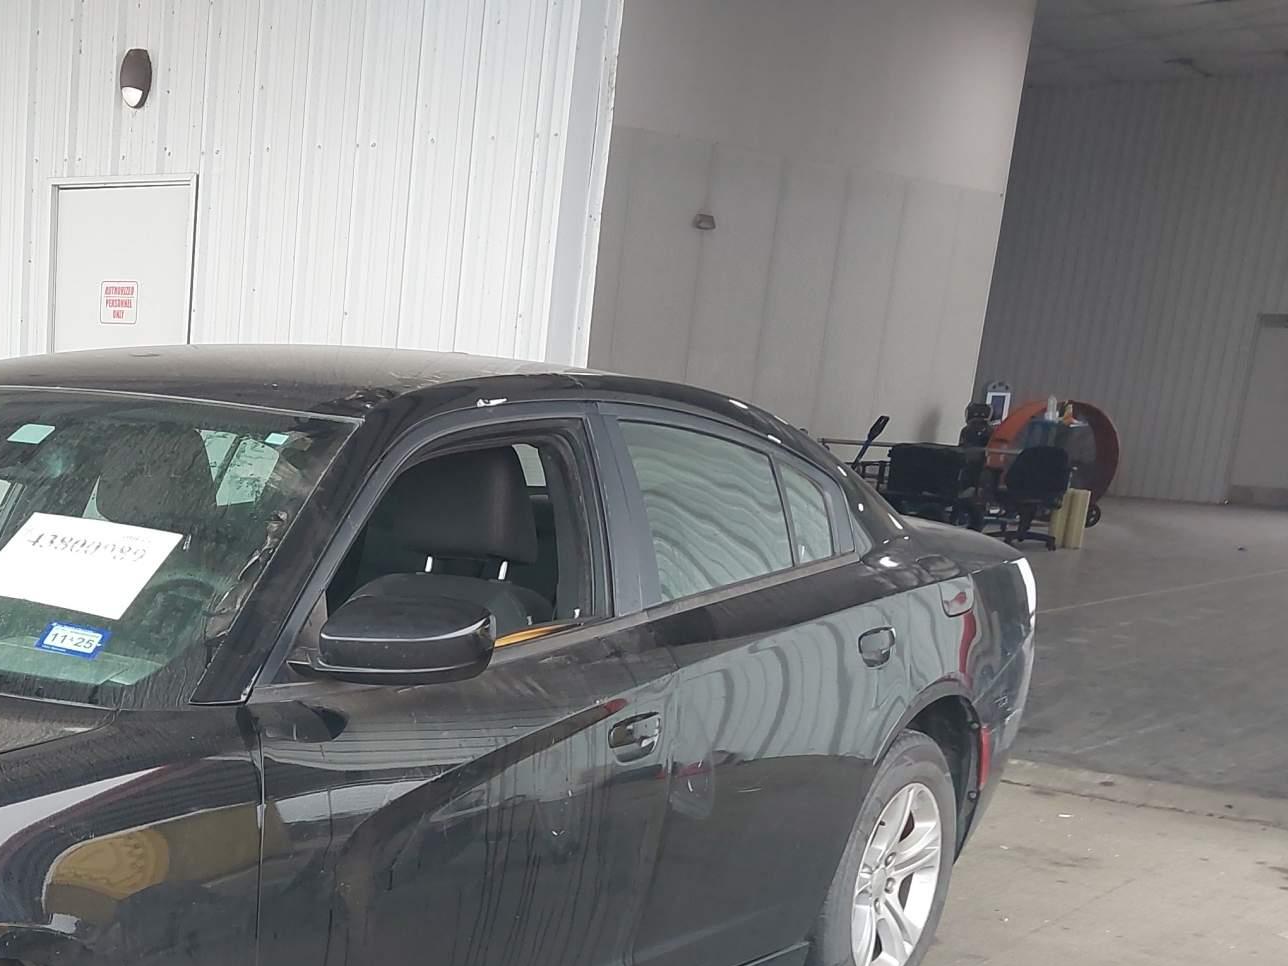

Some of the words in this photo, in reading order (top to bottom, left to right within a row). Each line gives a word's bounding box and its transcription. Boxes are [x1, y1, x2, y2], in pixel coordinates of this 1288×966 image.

[104, 285, 135, 296] AUTHORIZED
[105, 298, 133, 309] PERSONNEL
[112, 309, 125, 320] ONLY
